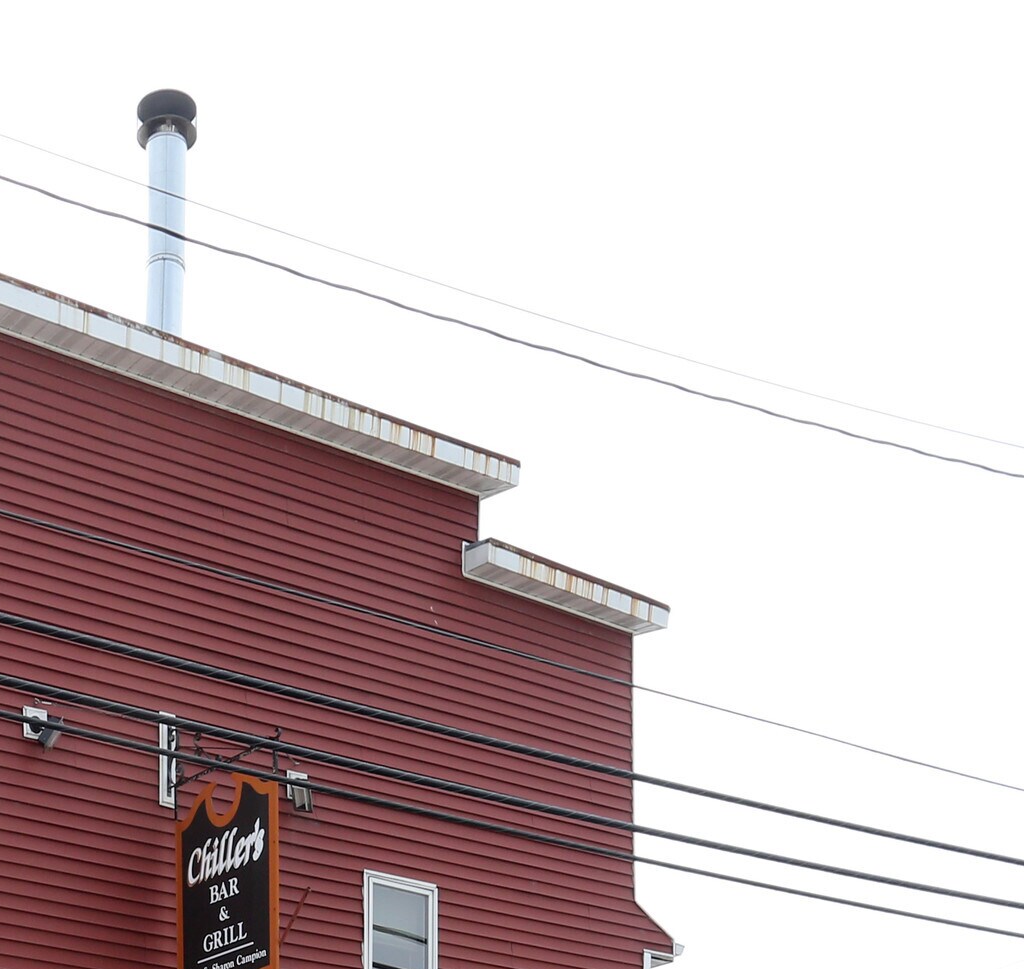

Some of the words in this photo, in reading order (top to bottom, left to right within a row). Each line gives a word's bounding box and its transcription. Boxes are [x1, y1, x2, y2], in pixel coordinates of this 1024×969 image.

[209, 877, 240, 904] BAR
[219, 906, 230, 921] &
[203, 922, 248, 952] GRILL
[236, 949, 267, 966] Campion
